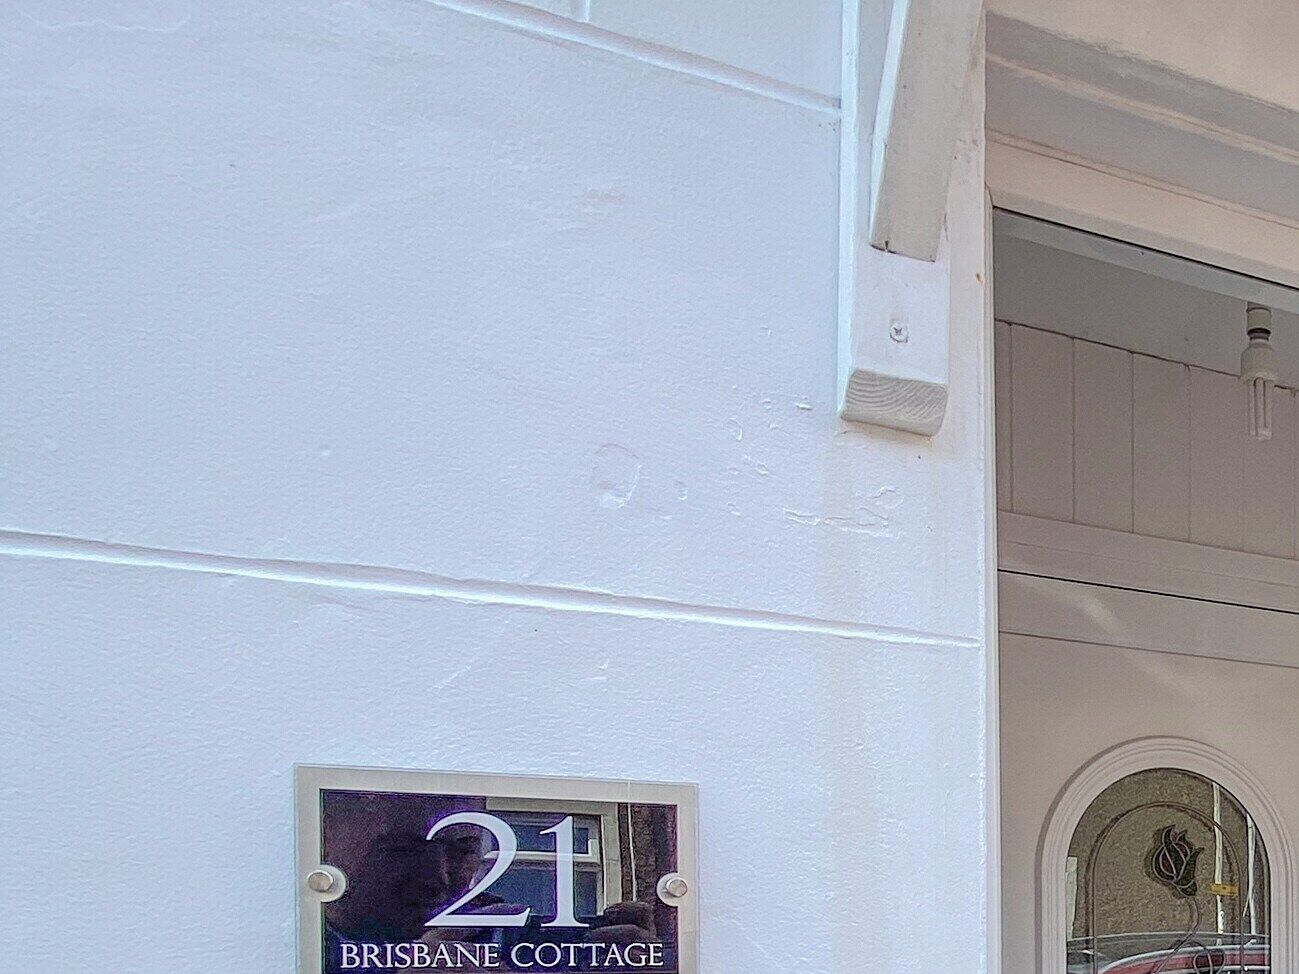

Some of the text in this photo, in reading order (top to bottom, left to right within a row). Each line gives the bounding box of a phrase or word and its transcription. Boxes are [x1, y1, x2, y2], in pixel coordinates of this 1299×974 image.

[424, 810, 590, 929] 21
[339, 942, 665, 969] BRISBANE COTTAGE
